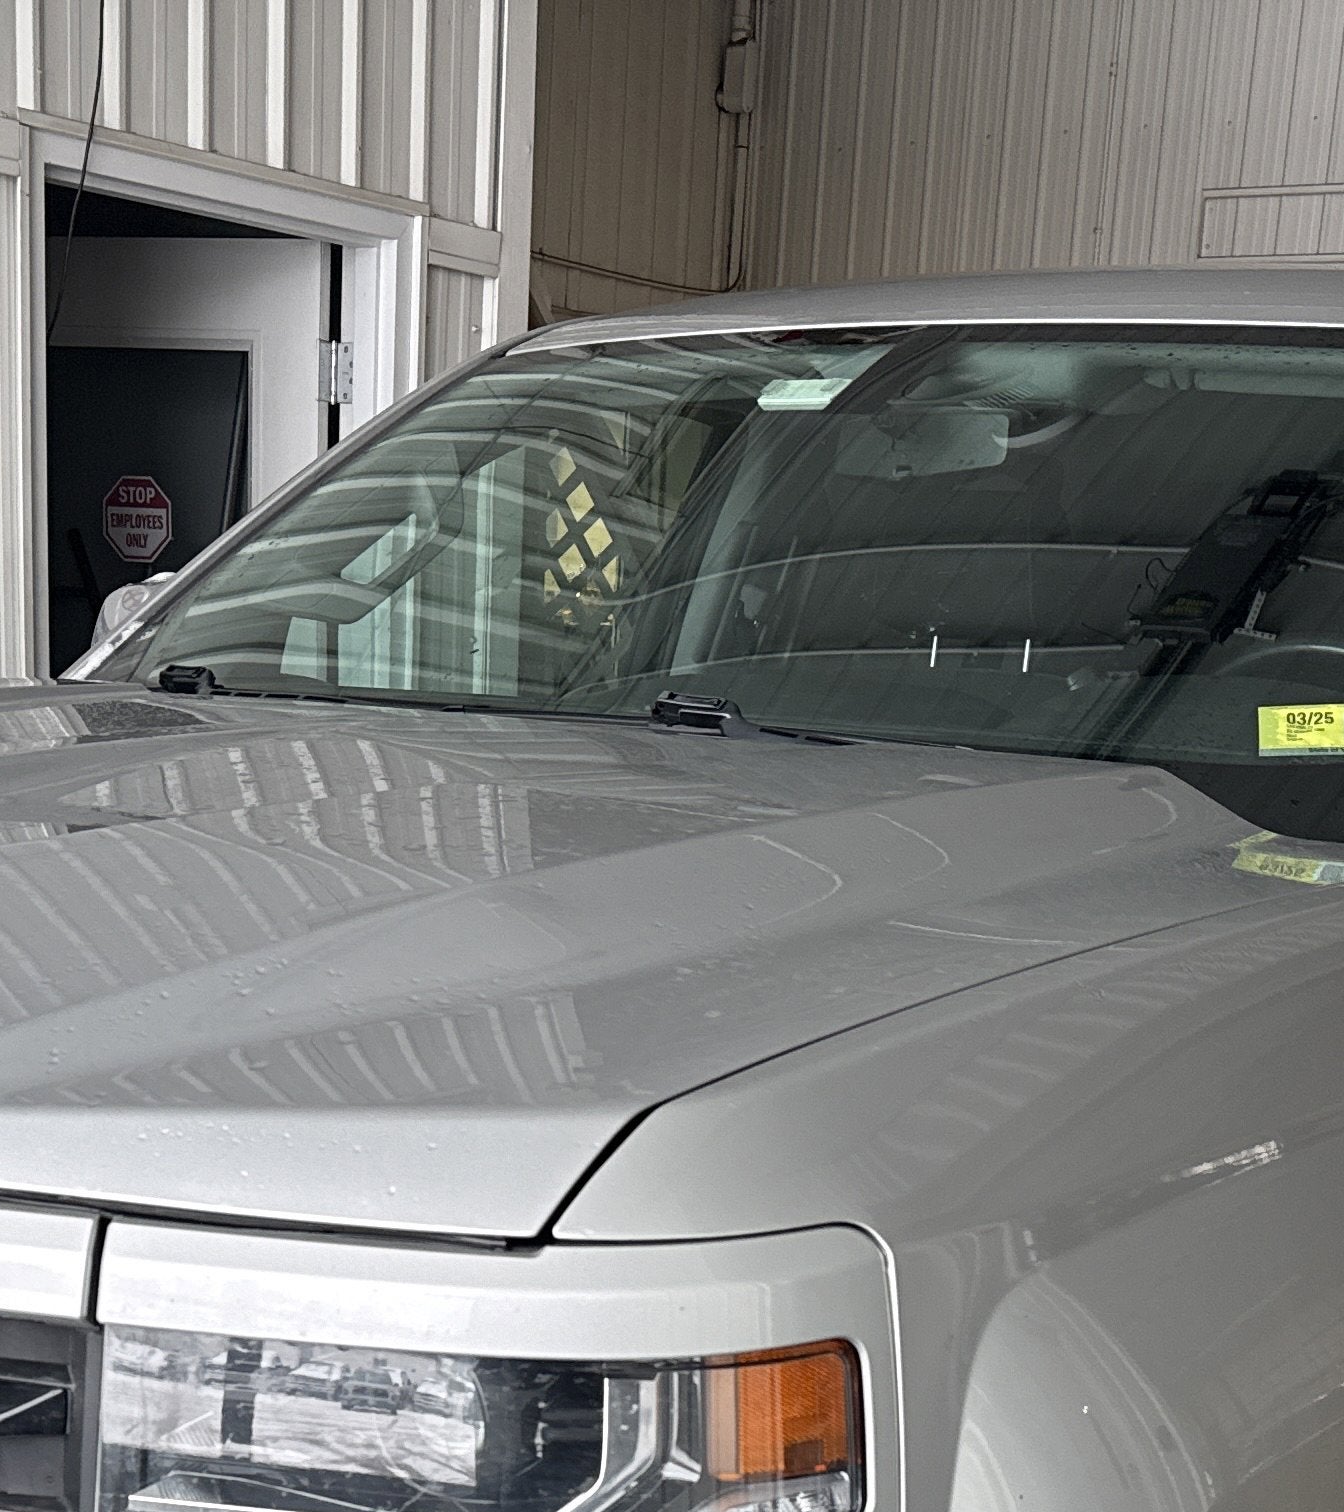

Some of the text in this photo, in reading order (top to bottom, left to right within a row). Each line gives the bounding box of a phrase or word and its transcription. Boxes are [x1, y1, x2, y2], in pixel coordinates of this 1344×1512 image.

[118, 486, 156, 504] STOP
[110, 513, 164, 530] EMPLOYEES
[125, 533, 149, 549] ONLY
[1286, 711, 1334, 725] 03/25
